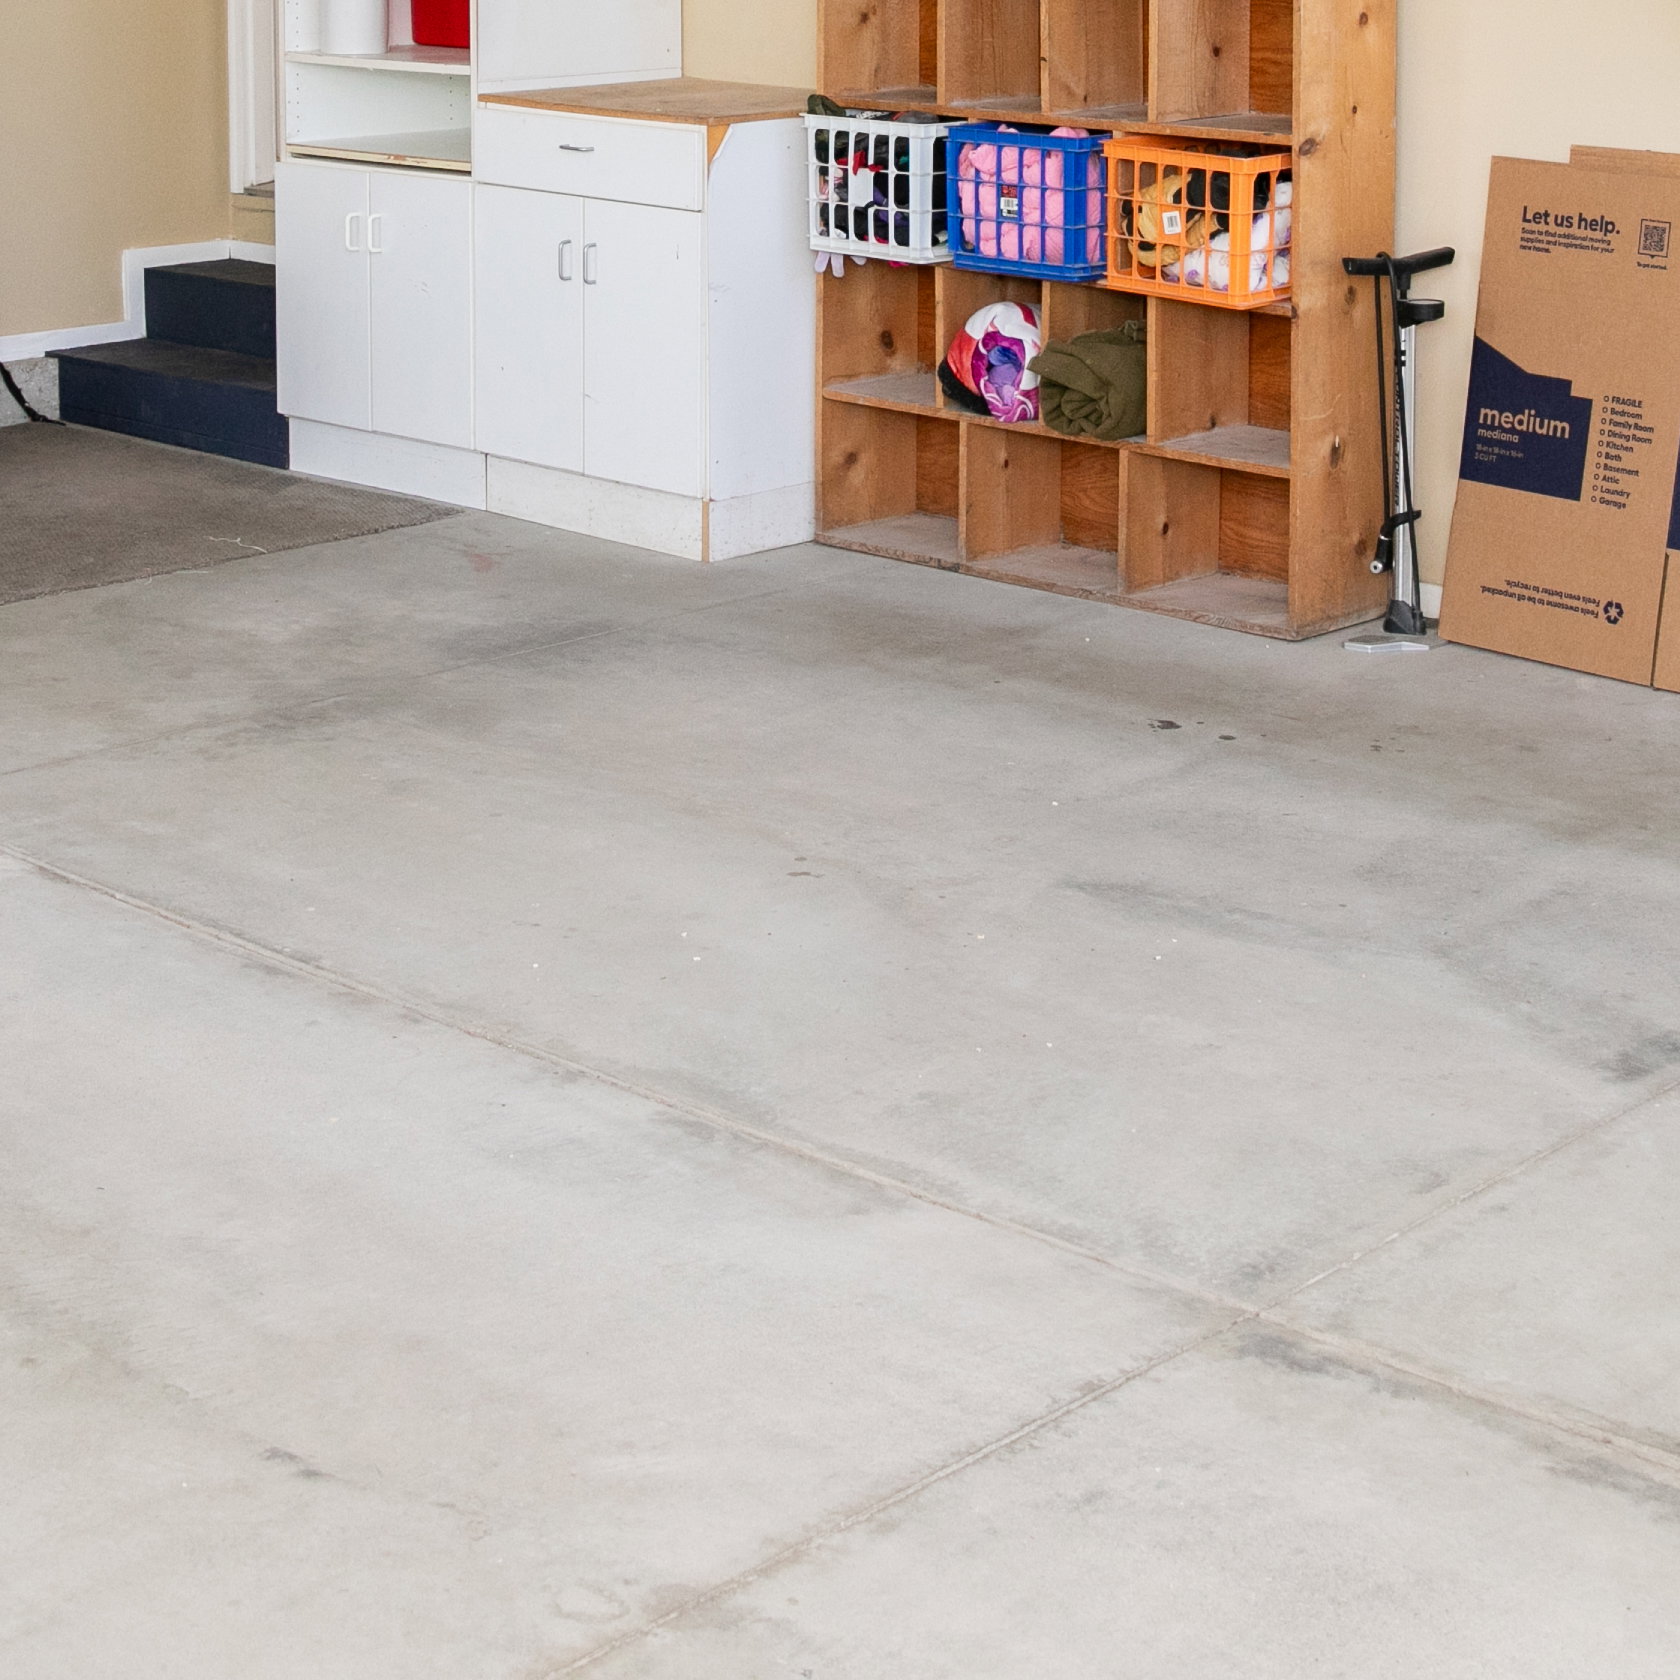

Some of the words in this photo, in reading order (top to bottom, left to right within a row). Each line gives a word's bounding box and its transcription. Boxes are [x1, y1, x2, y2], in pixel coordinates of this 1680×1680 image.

[1522, 205, 1551, 226] Let
[1554, 213, 1574, 228] us
[1577, 212, 1621, 237] help.
[1522, 227, 1536, 236] Scan
[1545, 229, 1556, 238] find
[1558, 232, 1588, 242] additional
[1589, 236, 1611, 246] moving
[1520, 235, 1545, 246] supplies
[1546, 238, 1557, 247] and
[1558, 239, 1590, 251] inspiration
[1591, 243, 1600, 252] for
[1600, 246, 1615, 254] your
[1612, 396, 1643, 408] FRAGILE
[1610, 407, 1642, 420] Bedroom
[1479, 407, 1570, 439] medium
[1609, 418, 1632, 431] Family
[1633, 422, 1654, 433] Room
[1477, 428, 1519, 443] mediana
[1608, 429, 1631, 442] Dining
[1632, 434, 1653, 444] Room
[1606, 440, 1634, 453] Kitchen
[1479, 453, 1489, 461] CU
[1489, 454, 1496, 462] FT
[1604, 452, 1622, 462] Bath
[1603, 463, 1639, 477] Basement
[1601, 474, 1620, 484] Attic
[1600, 485, 1631, 499] Laundry
[1599, 496, 1626, 509] Garage
[1505, 579, 1532, 591] recycle.
[1532, 586, 1540, 594] to
[1541, 588, 1563, 599] better
[1564, 592, 1581, 601] even
[1527, 596, 1536, 605] be
[1546, 600, 1580, 613] awesome
[1582, 596, 1601, 607] Feels
[1580, 608, 1599, 618] Feels
